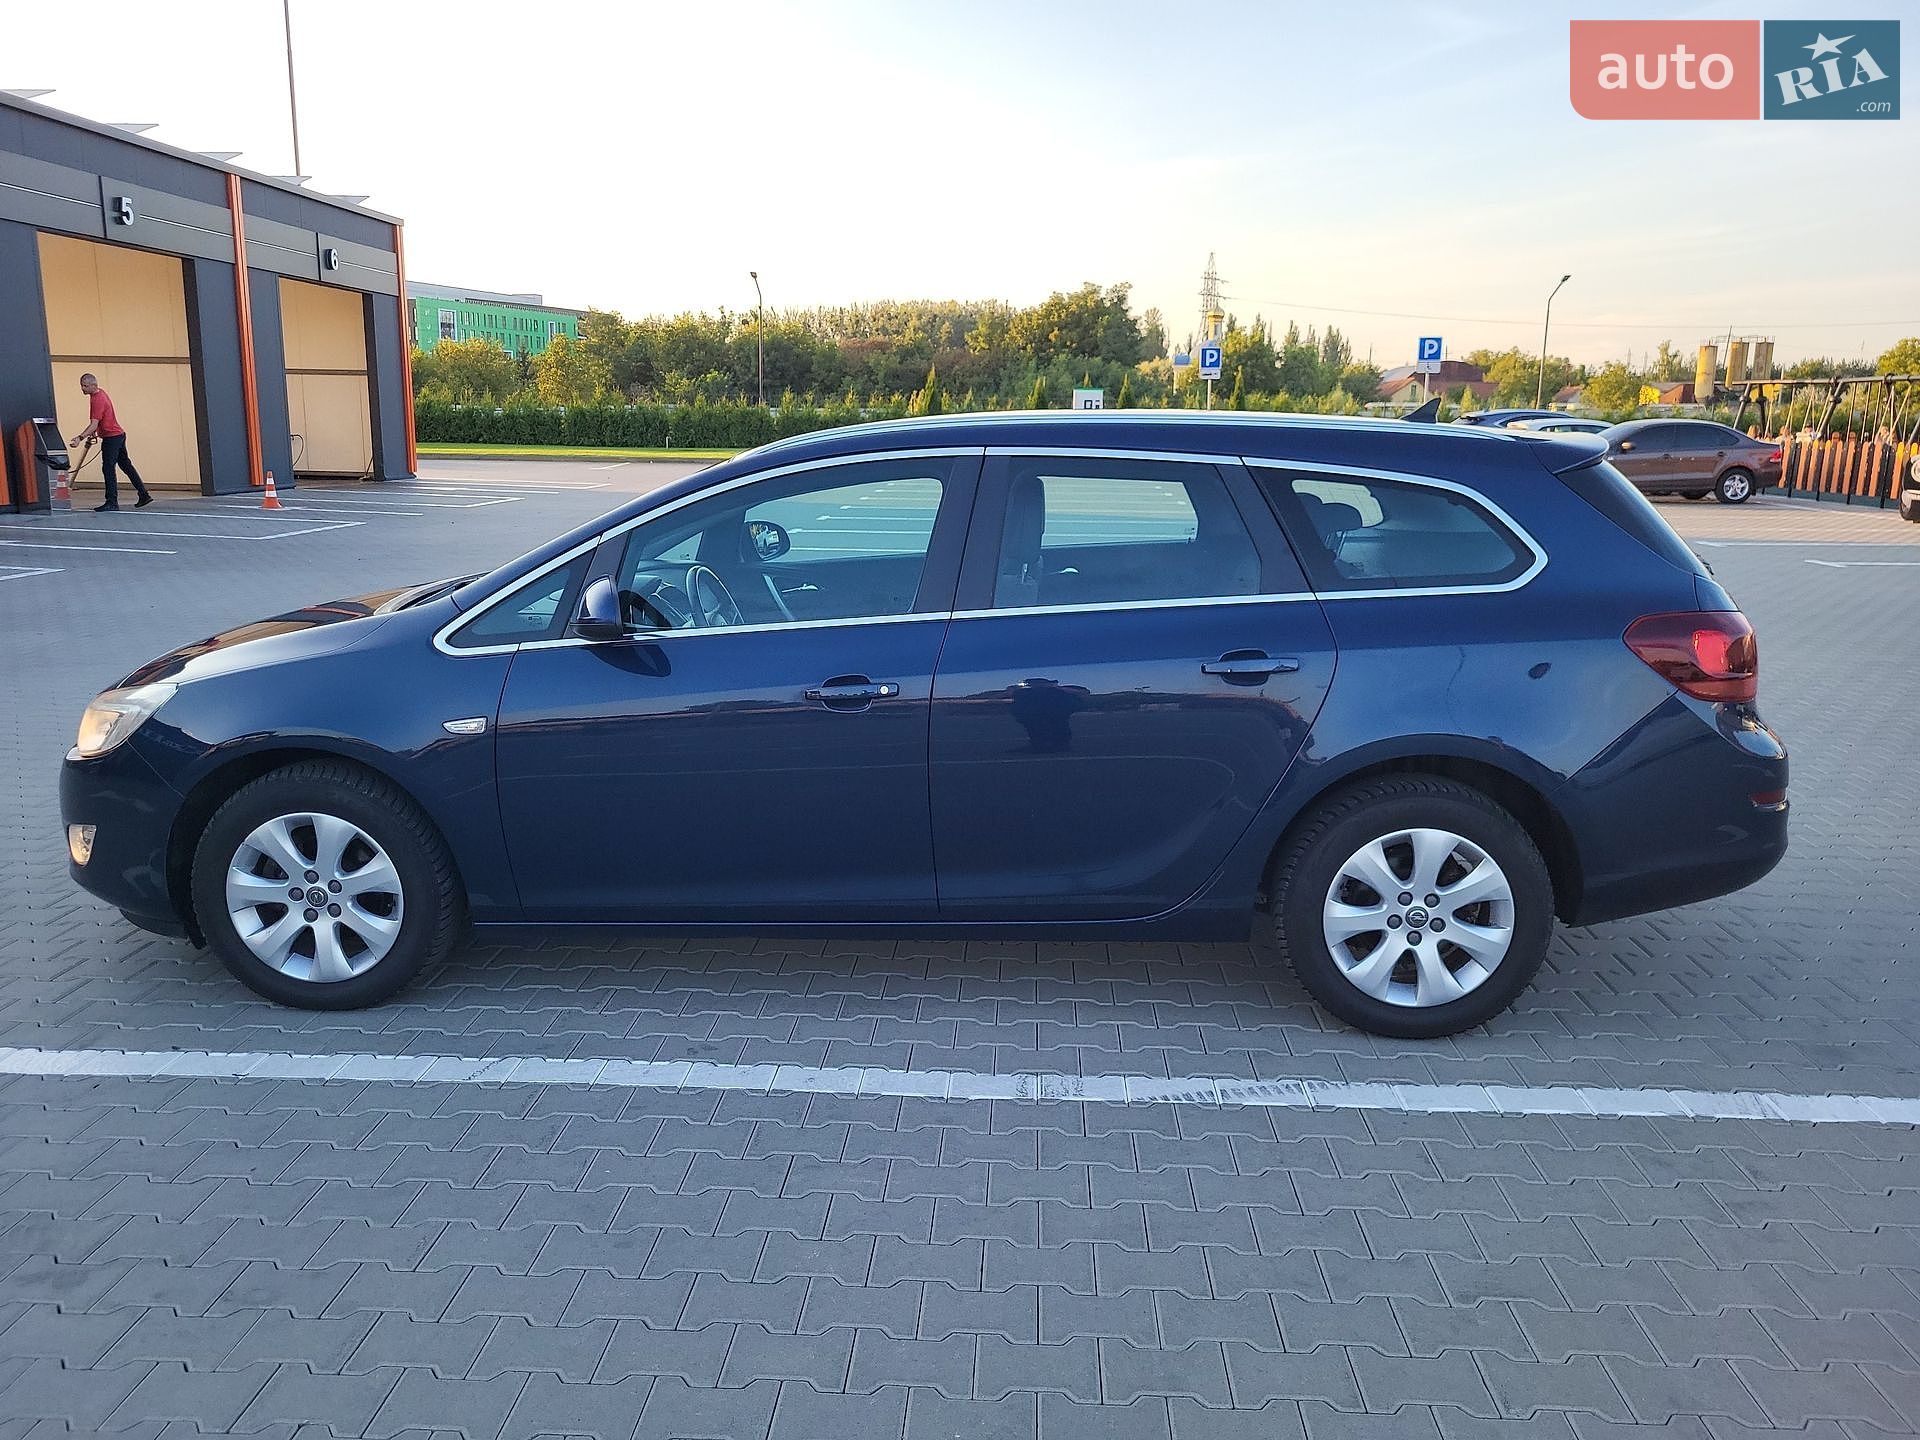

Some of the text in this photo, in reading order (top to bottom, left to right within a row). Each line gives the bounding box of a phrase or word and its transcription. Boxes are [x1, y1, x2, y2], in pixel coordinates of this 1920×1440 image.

[119, 196, 134, 225] 5
[329, 248, 339, 270] 6
[1205, 349, 1218, 367] P
[1424, 339, 1439, 359] P
